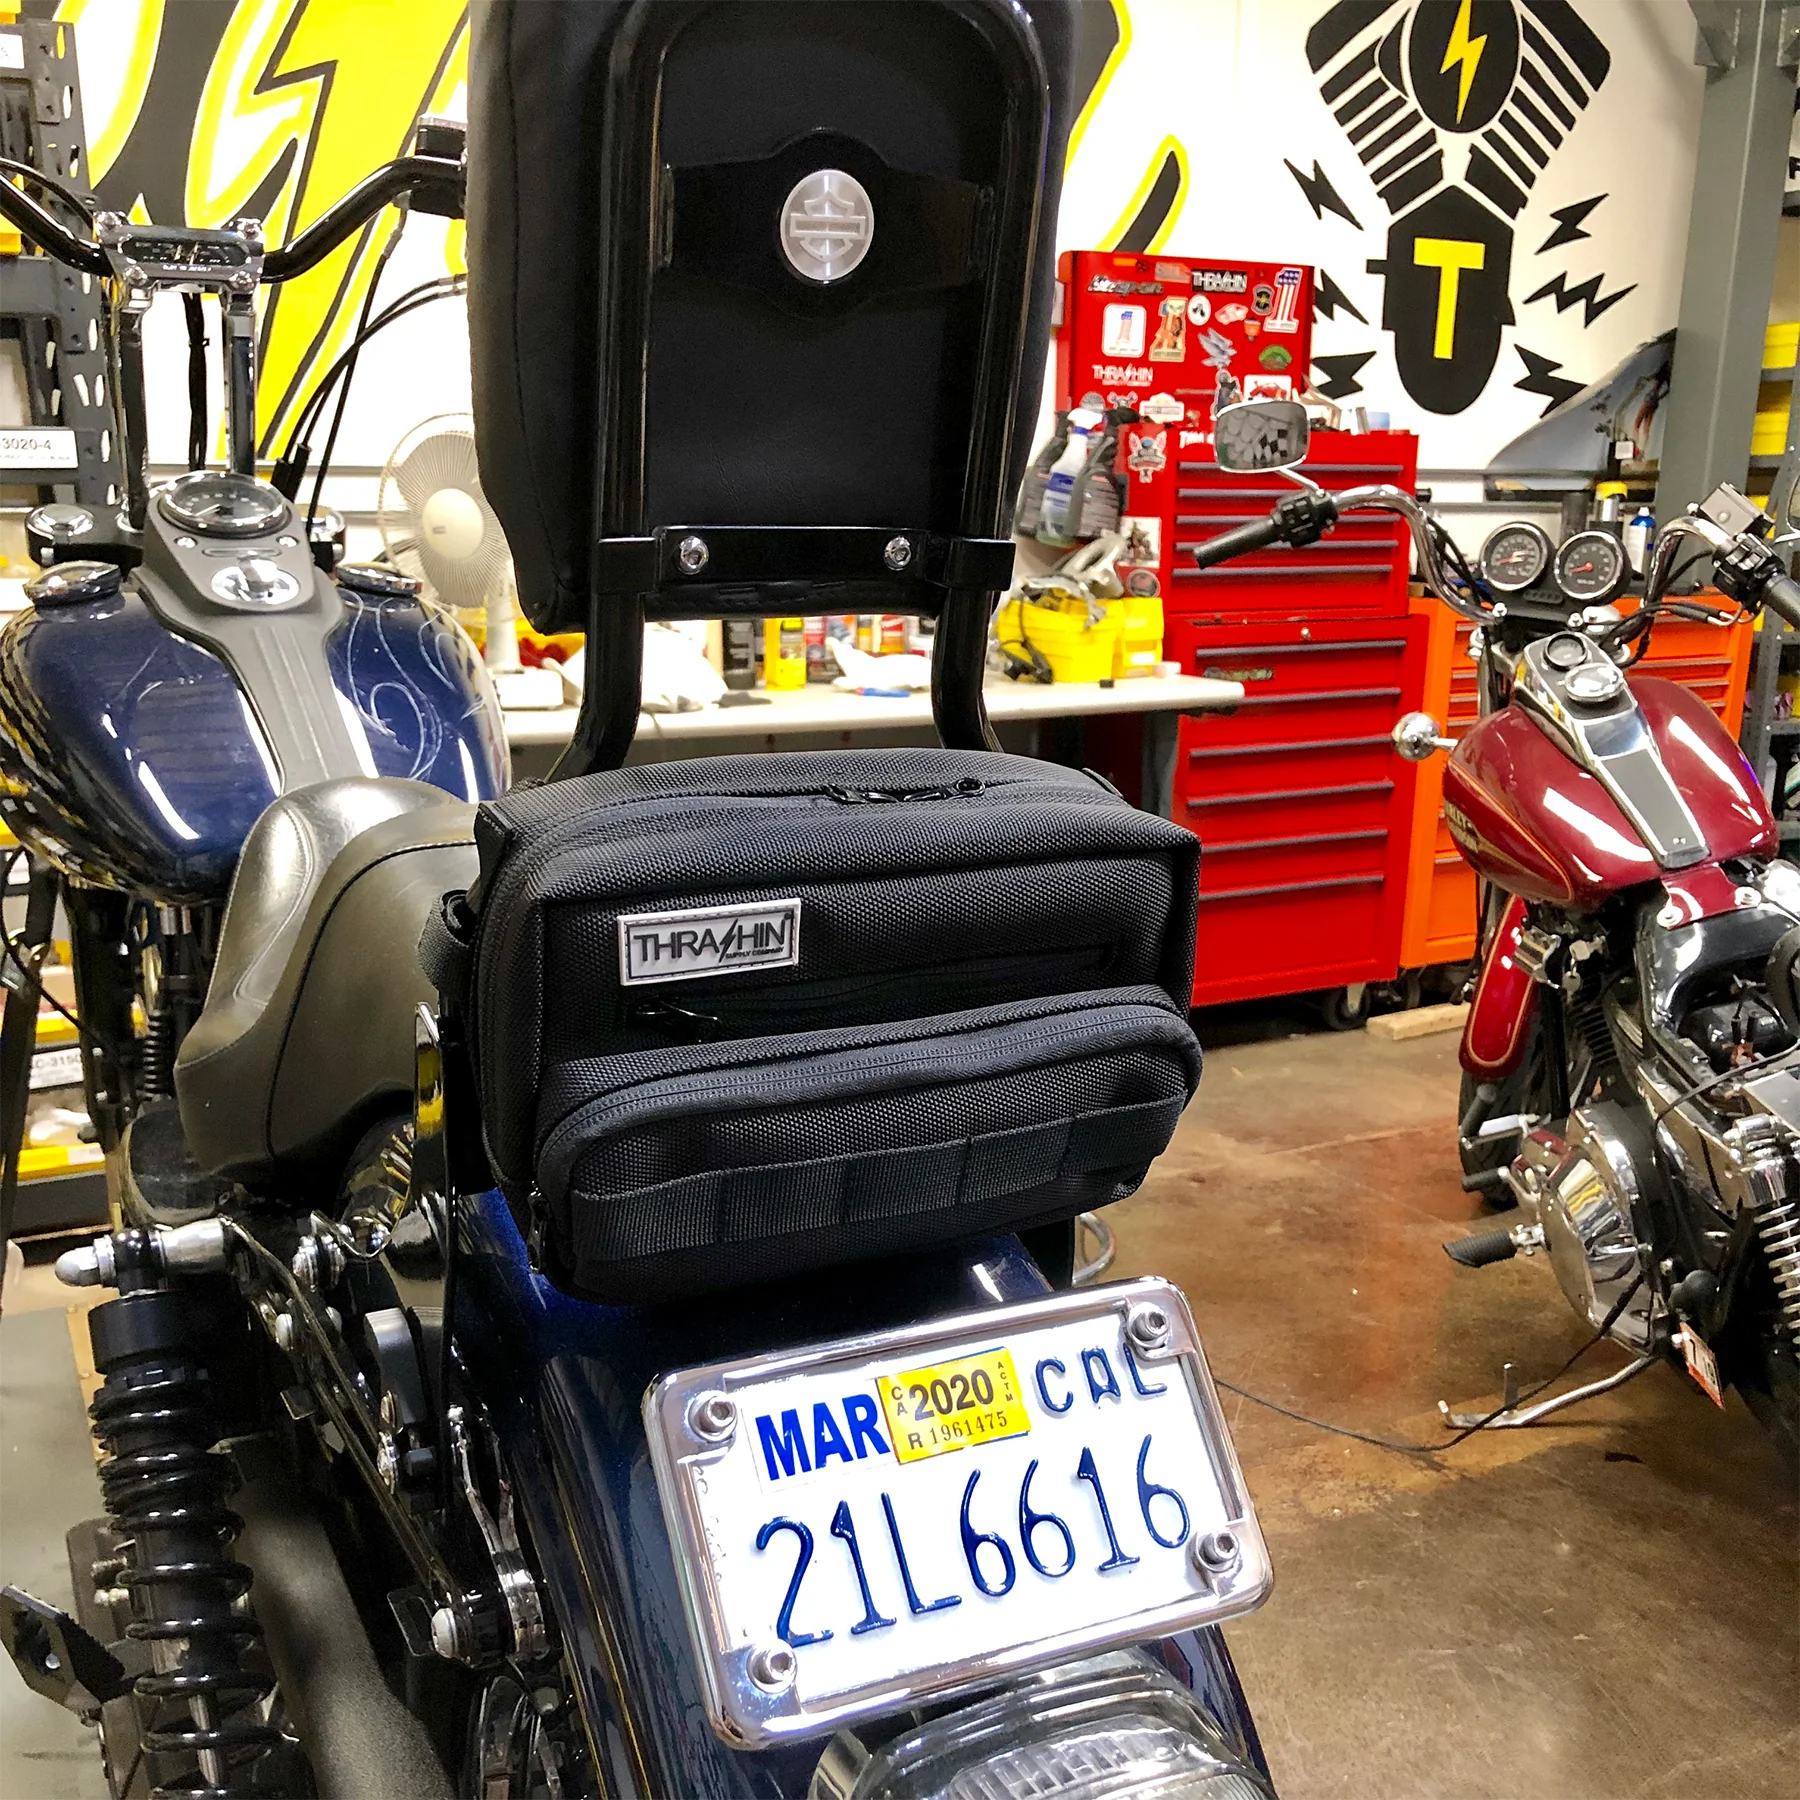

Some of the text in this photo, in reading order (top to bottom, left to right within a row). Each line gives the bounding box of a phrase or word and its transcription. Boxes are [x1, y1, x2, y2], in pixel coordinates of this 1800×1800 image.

[1413, 237, 1486, 360] T
[755, 1393, 891, 1481] MAR
[909, 1369, 994, 1421] 2020
[929, 1411, 1008, 1445] 1961475
[756, 1434, 1190, 1648] 21L6616
